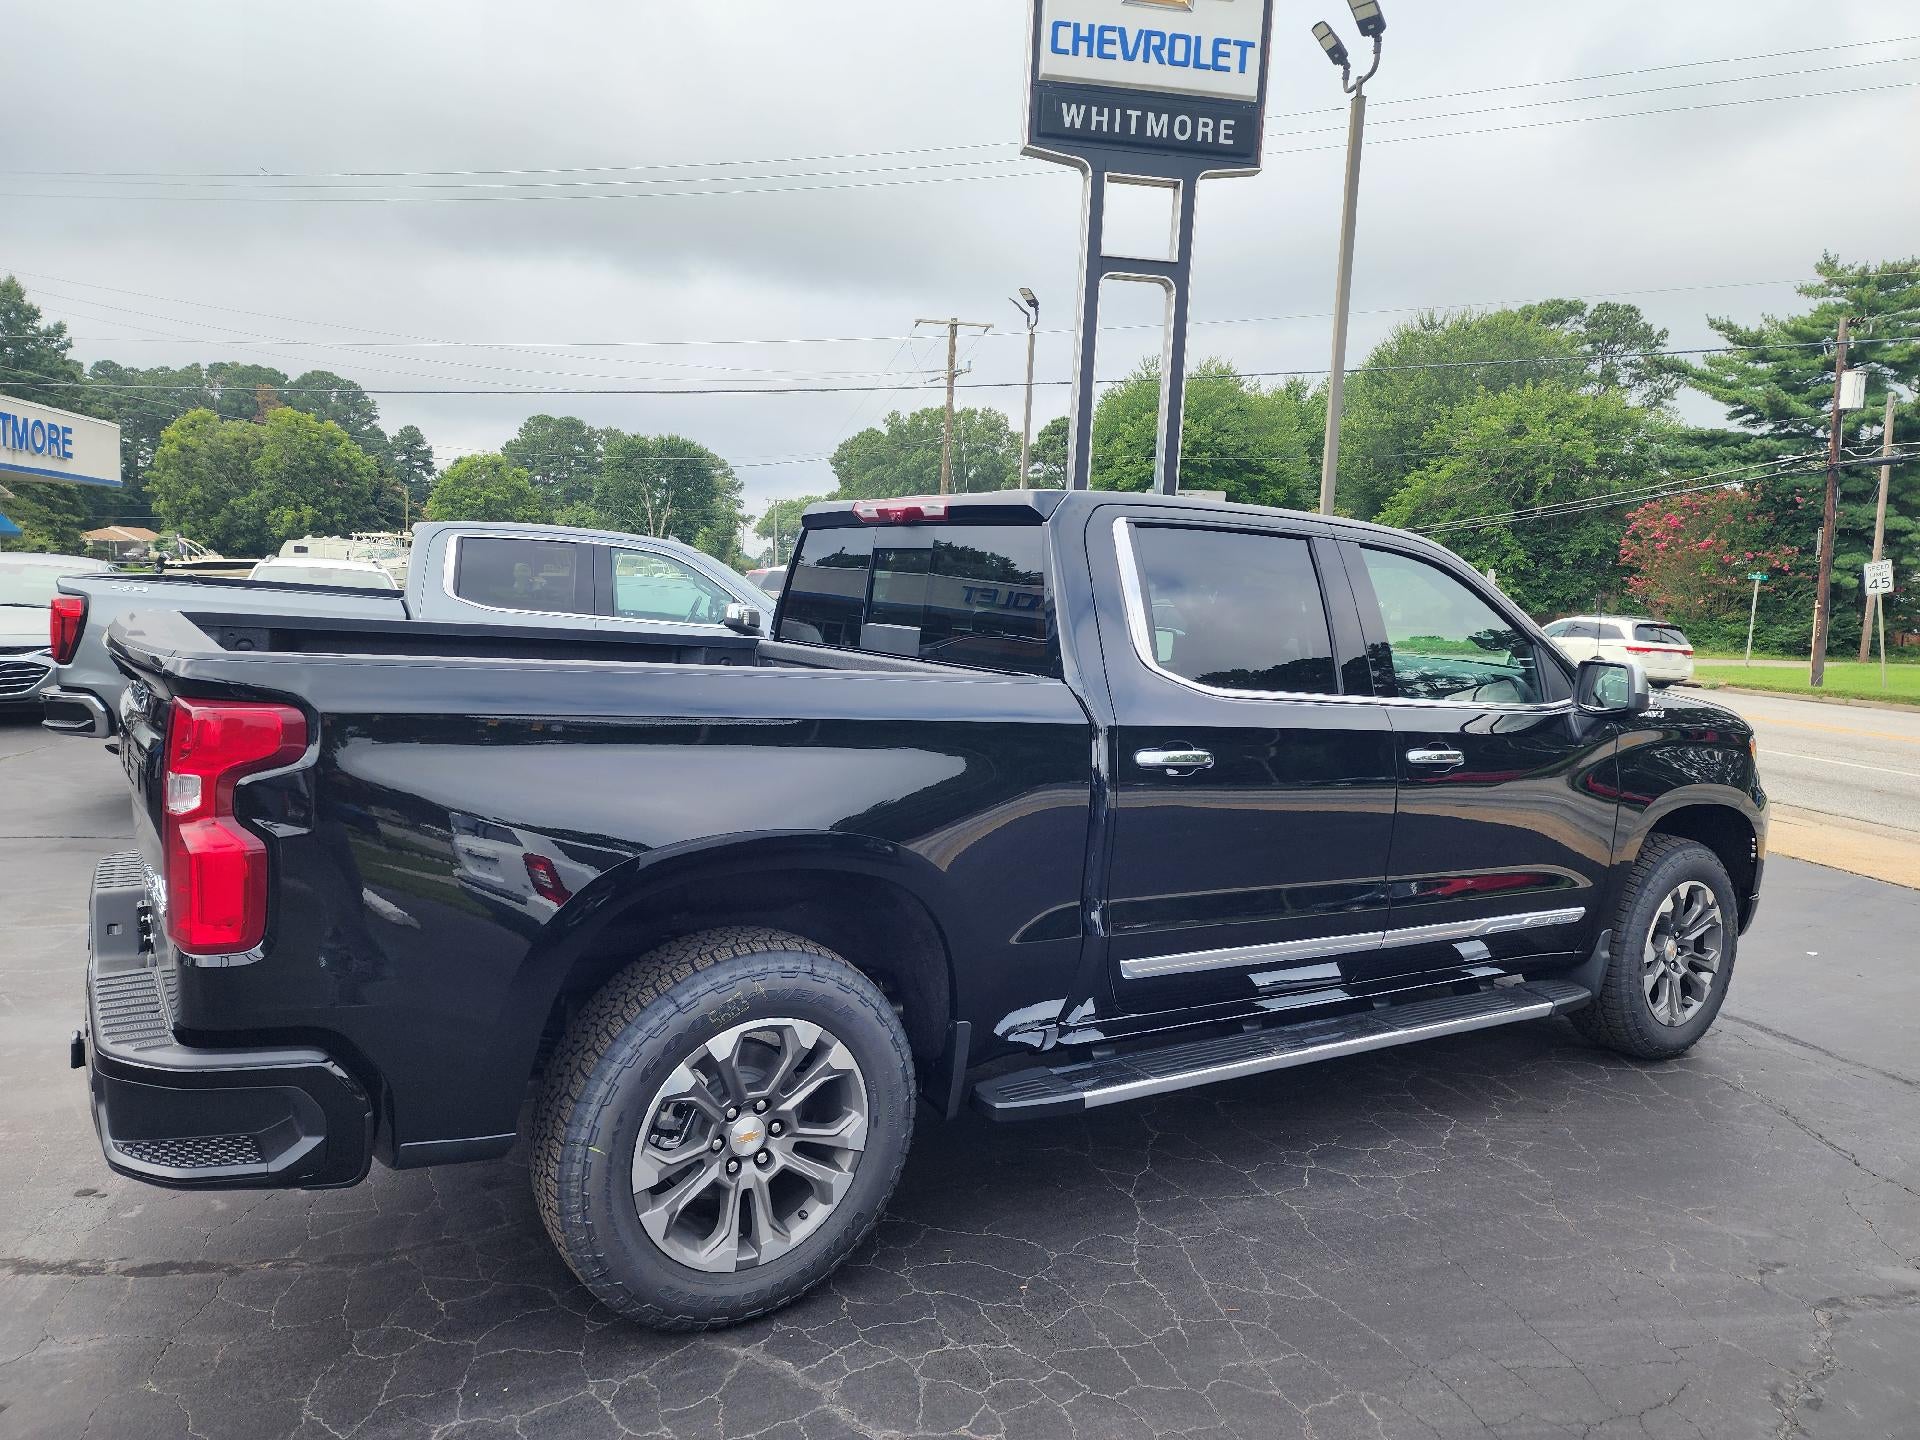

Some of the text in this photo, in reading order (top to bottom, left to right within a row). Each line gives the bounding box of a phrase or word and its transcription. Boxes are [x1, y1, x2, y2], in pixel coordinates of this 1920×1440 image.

[1050, 20, 1255, 74] CHEVROLET
[1061, 102, 1235, 145] WHITMORE
[1868, 576, 1891, 590] 45
